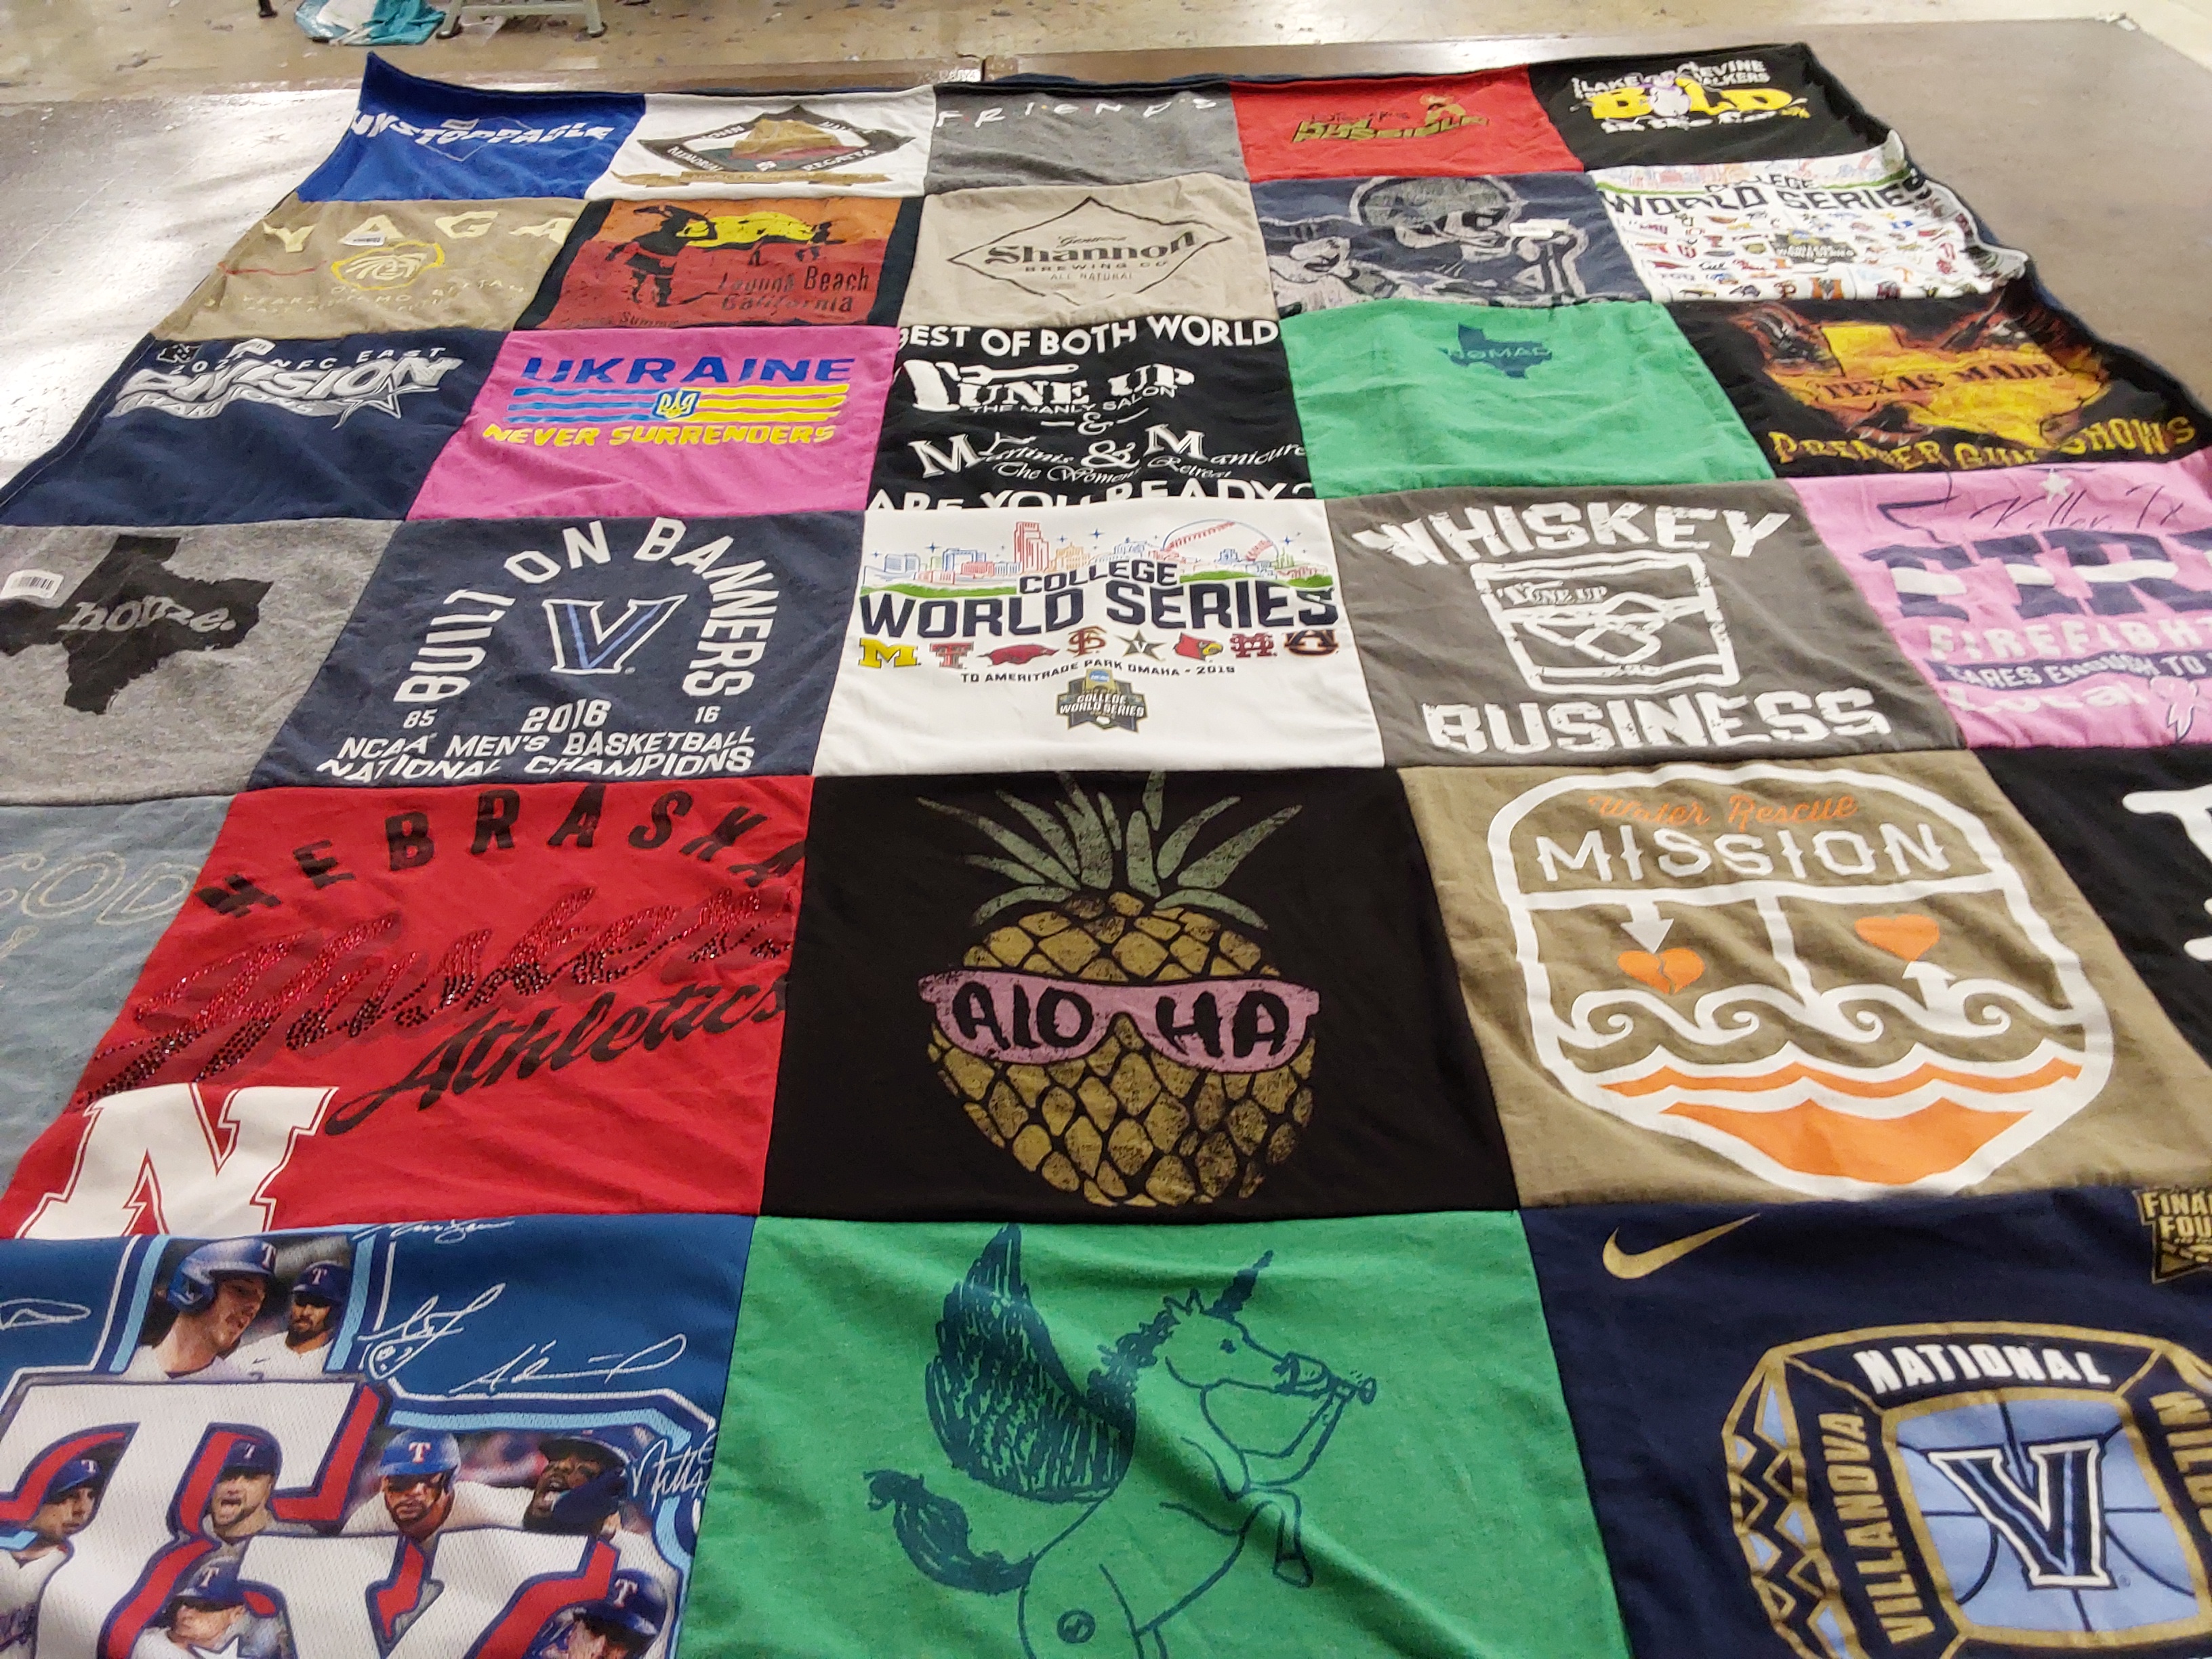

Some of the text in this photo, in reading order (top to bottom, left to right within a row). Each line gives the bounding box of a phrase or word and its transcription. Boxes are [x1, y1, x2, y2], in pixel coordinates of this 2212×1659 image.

[350, 110, 615, 145] UNSTOPPABLE
[936, 97, 1217, 127] FRIENDS
[1599, 185, 1768, 216] WORLD
[263, 211, 575, 253] YAGA
[985, 231, 1193, 264] Shannon
[803, 266, 869, 291] Beach
[1025, 260, 1127, 272] BREWING
[981, 329, 1031, 356] OF
[1040, 318, 1136, 355] BOTH
[1147, 314, 1279, 346] WORLD
[272, 356, 338, 370] NFC
[356, 347, 447, 363] EAST
[523, 356, 855, 384] UKRAINE
[895, 359, 1195, 411] TUNE UP
[1815, 363, 2064, 400] TEXAS MADE
[969, 386, 1175, 413] THE MANLY SALON
[483, 424, 835, 447] NEVER SURRENDERS
[1767, 416, 2196, 471] PREMIER GUN SHOWS
[992, 462, 1042, 480] The
[1081, 440, 1141, 470] &
[1351, 501, 1791, 566] WHISKEY
[1018, 559, 1178, 594] COLLEGE
[56, 595, 237, 632] home.
[394, 516, 780, 703] BUILT ON BANNERS
[859, 579, 1339, 638] WORLD SERIES
[985, 662, 1079, 683] AMERITRADE
[1084, 659, 1123, 670] PARK
[1128, 663, 1180, 676] OMAHA
[2160, 655, 2207, 676] TO
[403, 699, 720, 733] 85 2016 16
[1060, 702, 1101, 714] WORLD
[1103, 703, 1144, 717] SERIES
[1077, 693, 1127, 704] COLLEGE
[1421, 688, 1891, 754] BUSINESS
[337, 726, 755, 758] NCAA MEN'S BASKETBALL
[316, 746, 754, 783] NATIONAL CHAMPIONS
[1588, 793, 1858, 833] Water Rescue
[196, 785, 805, 918] NEBRASKA
[1535, 821, 1952, 882] MISSION
[327, 972, 788, 1136] Athletics
[16, 1083, 339, 1238] N
[2142, 1190, 2212, 1218] FINA
[1854, 1344, 2112, 1394] NATIONAL
[1818, 1412, 1936, 1645] VILLANOVA
